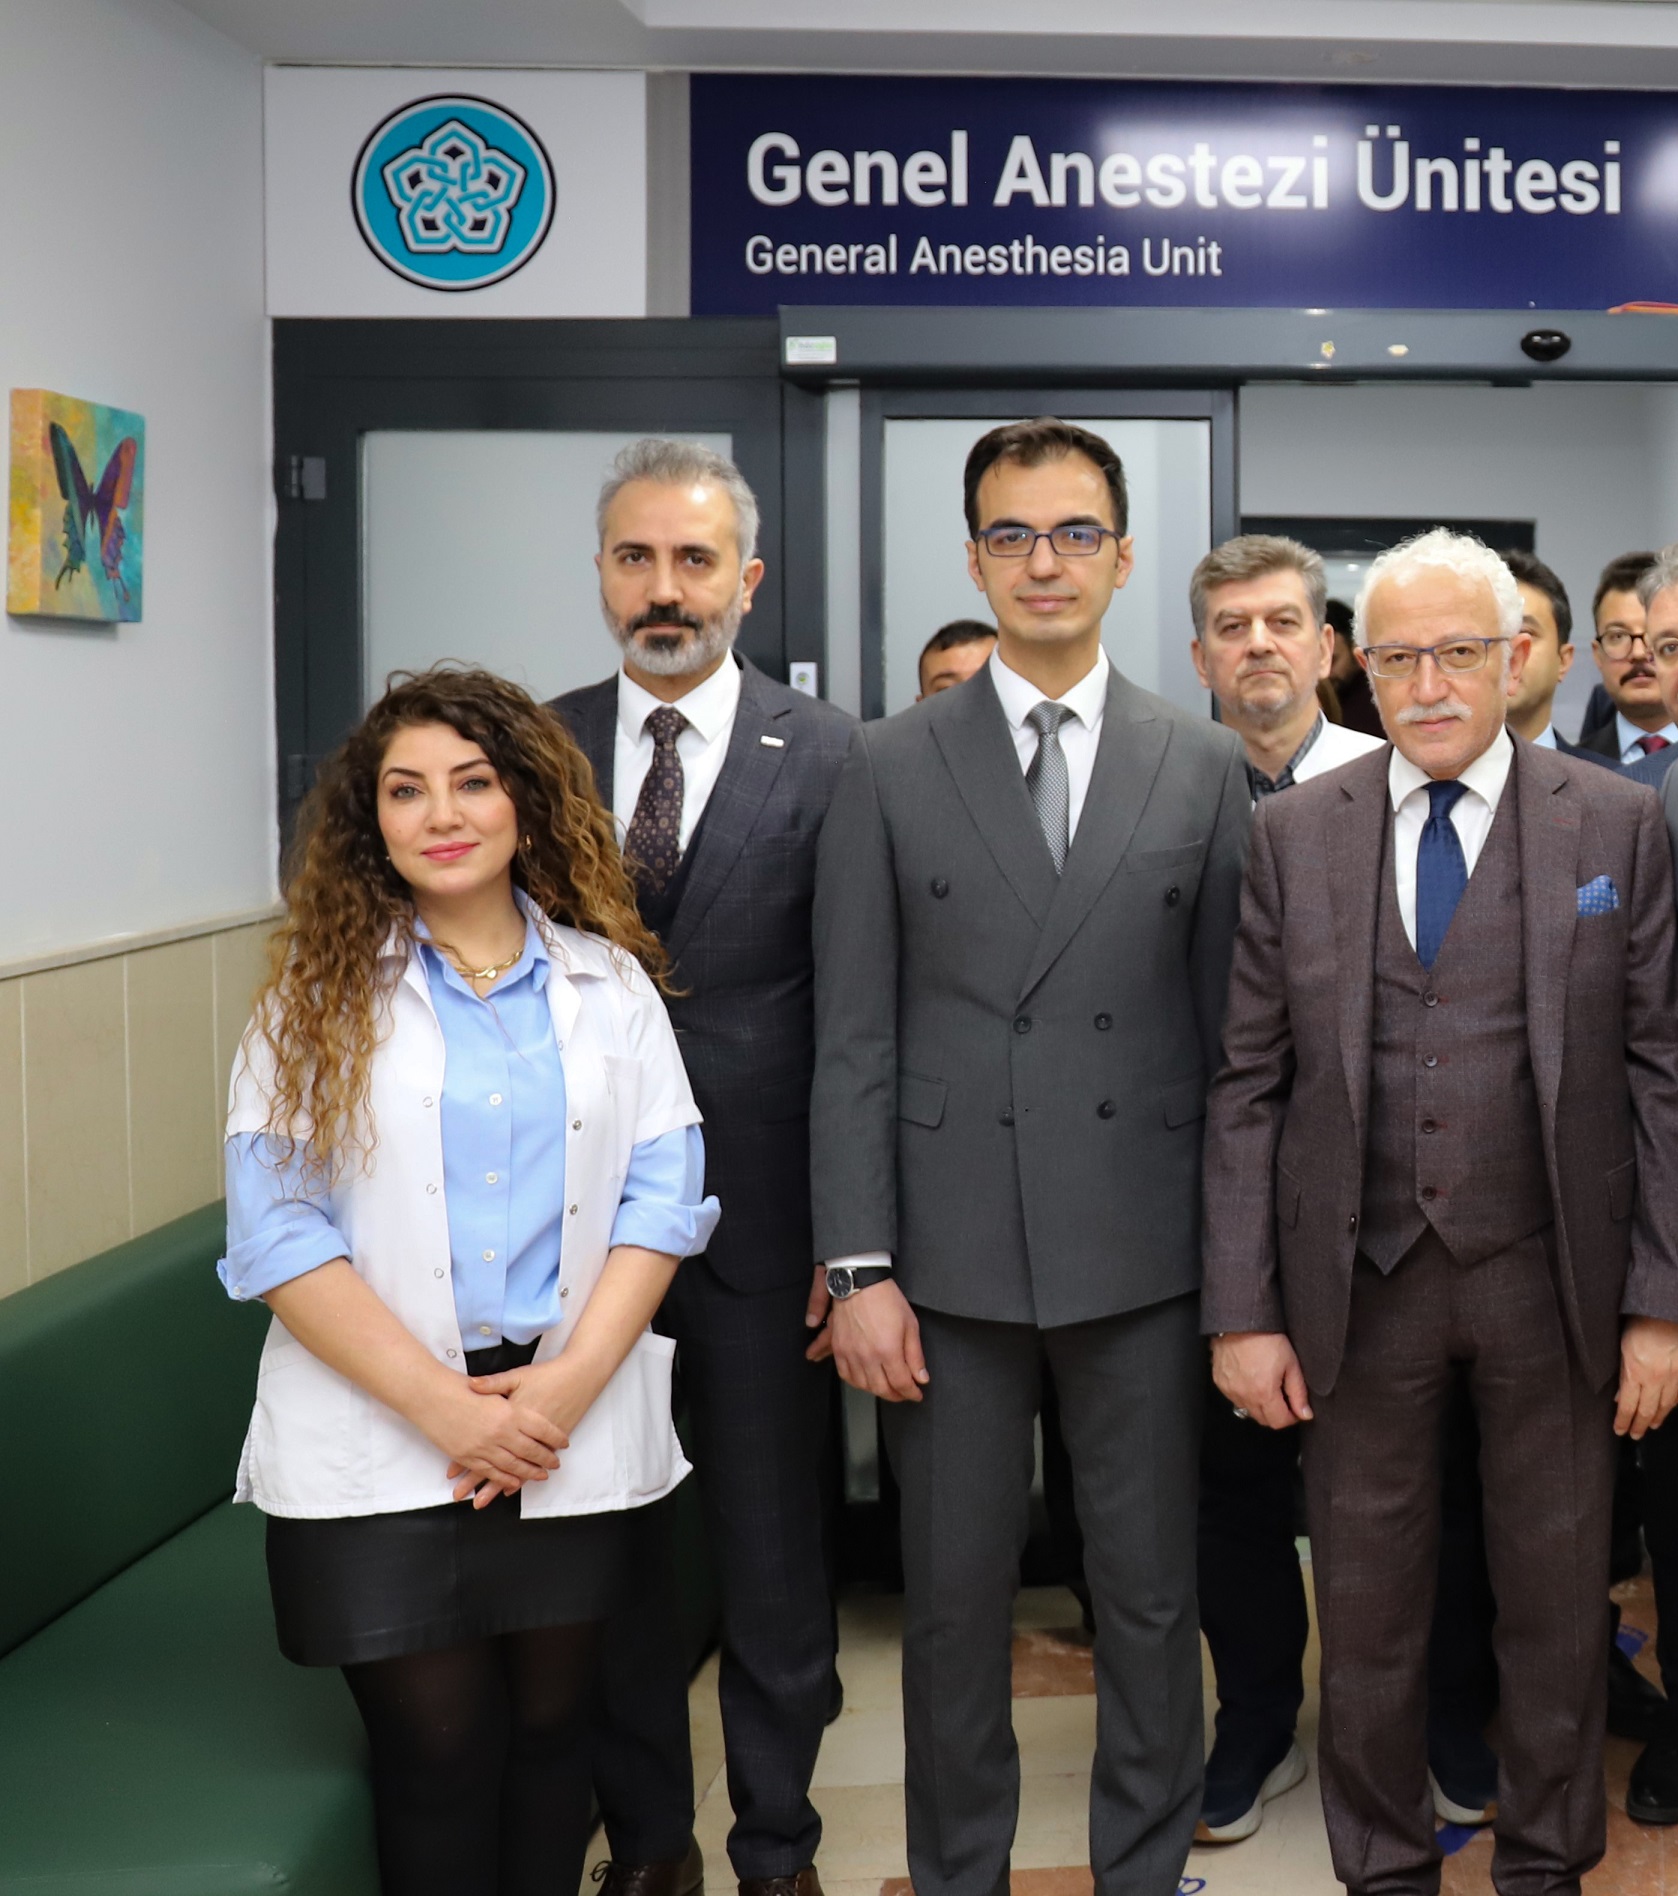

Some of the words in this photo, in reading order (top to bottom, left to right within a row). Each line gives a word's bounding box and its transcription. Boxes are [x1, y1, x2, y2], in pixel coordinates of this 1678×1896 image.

[748, 130, 968, 206] Genel
[994, 135, 1329, 210] Anestezi
[1357, 124, 1621, 214] Ünitesi
[745, 234, 897, 275] General
[910, 235, 1130, 276] Anesthesia
[1141, 237, 1222, 277] Unit
